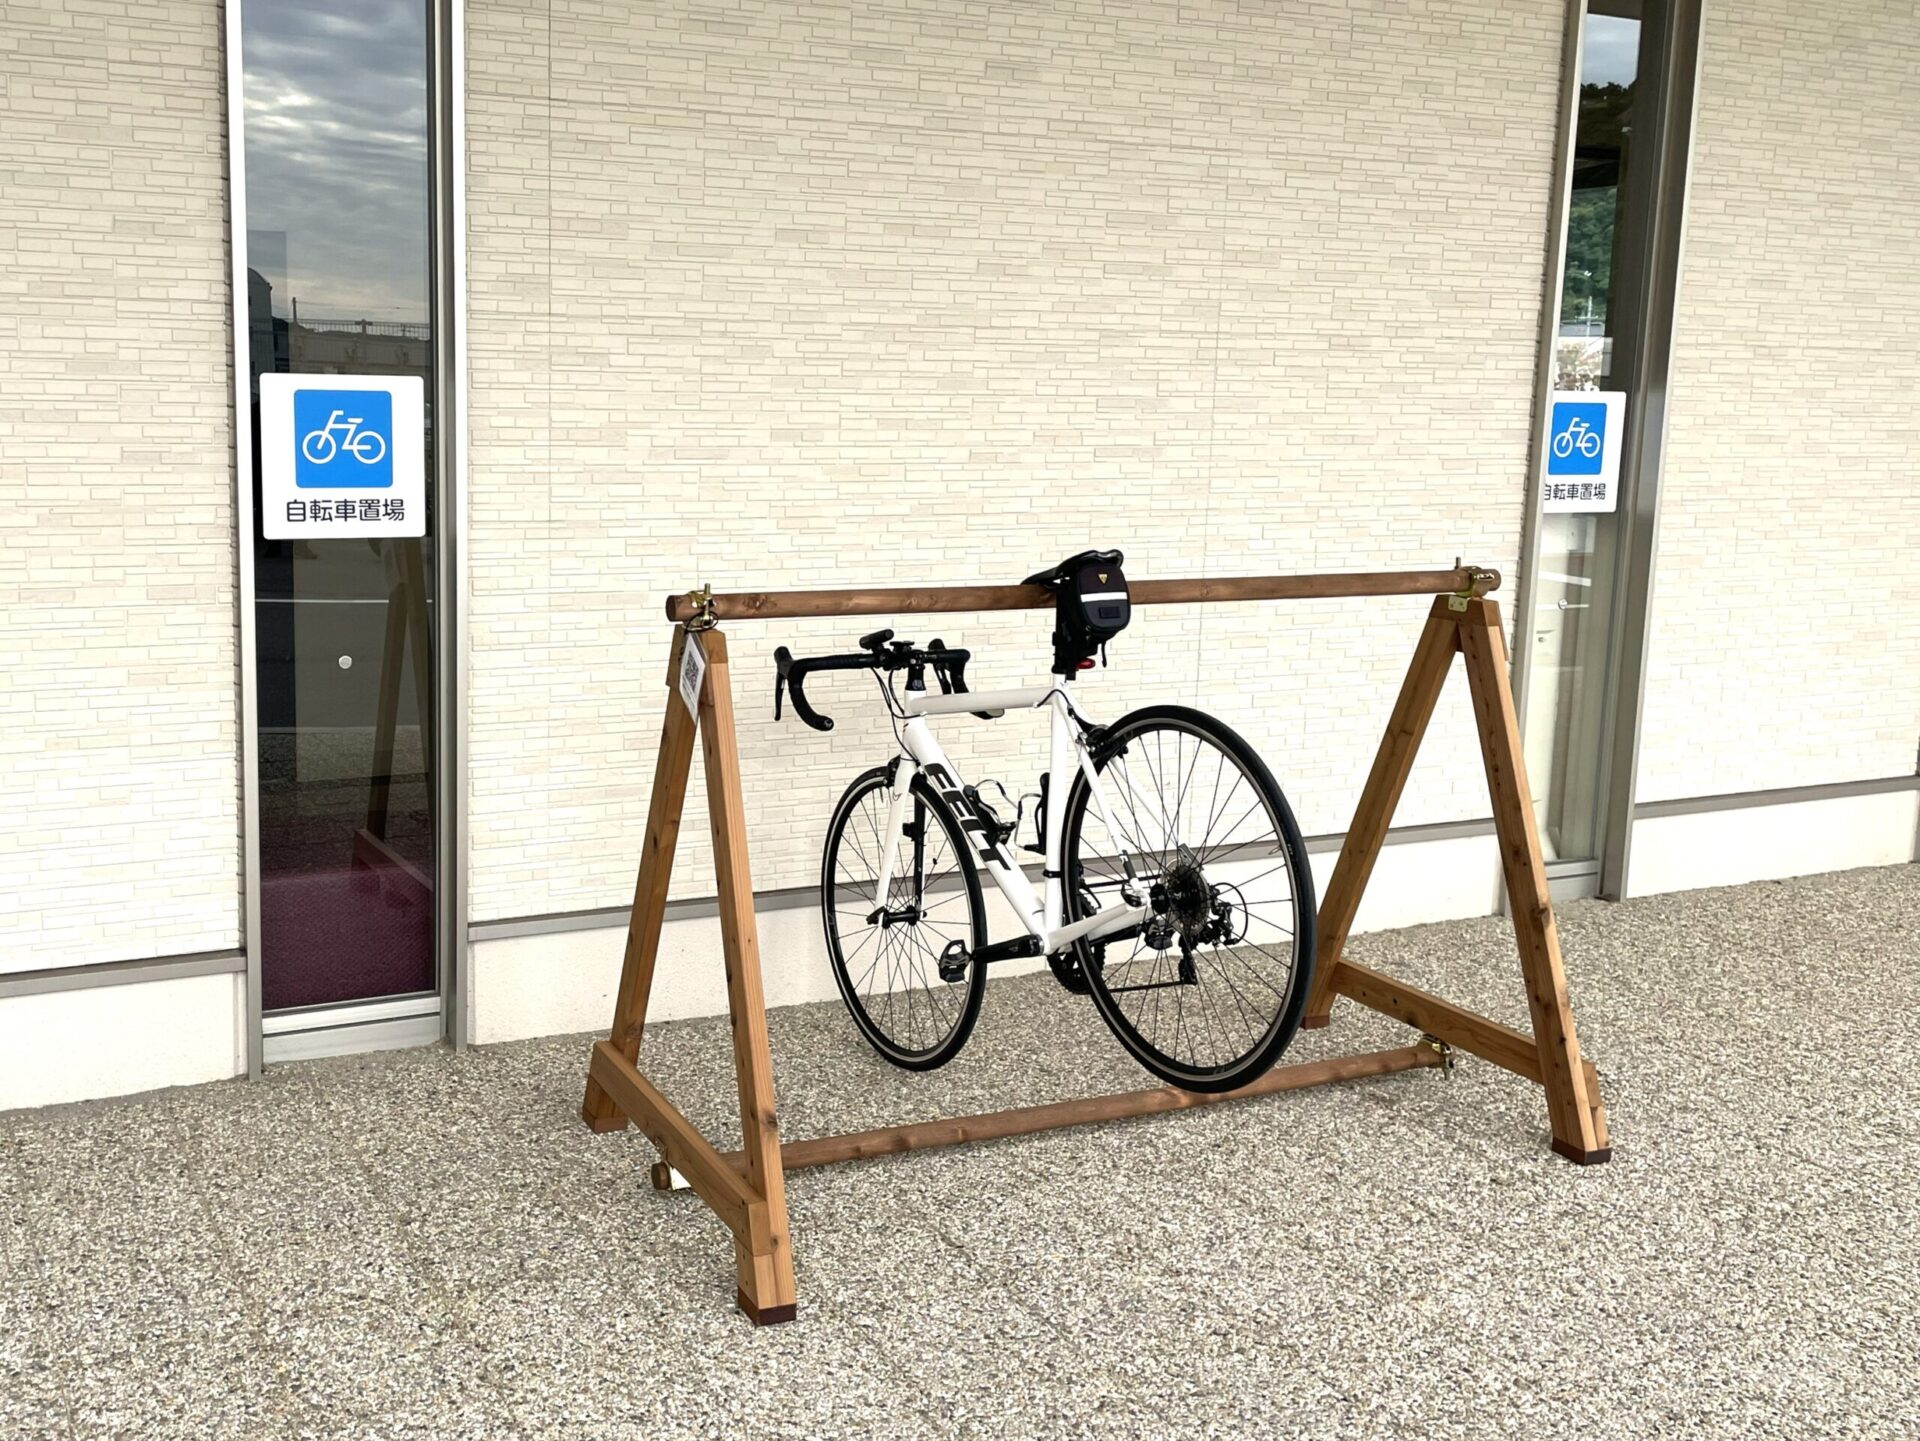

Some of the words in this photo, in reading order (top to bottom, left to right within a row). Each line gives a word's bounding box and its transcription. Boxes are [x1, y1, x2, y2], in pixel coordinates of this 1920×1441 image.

[286, 498, 405, 522] 自転車置場
[924, 763, 1012, 871] FELT
